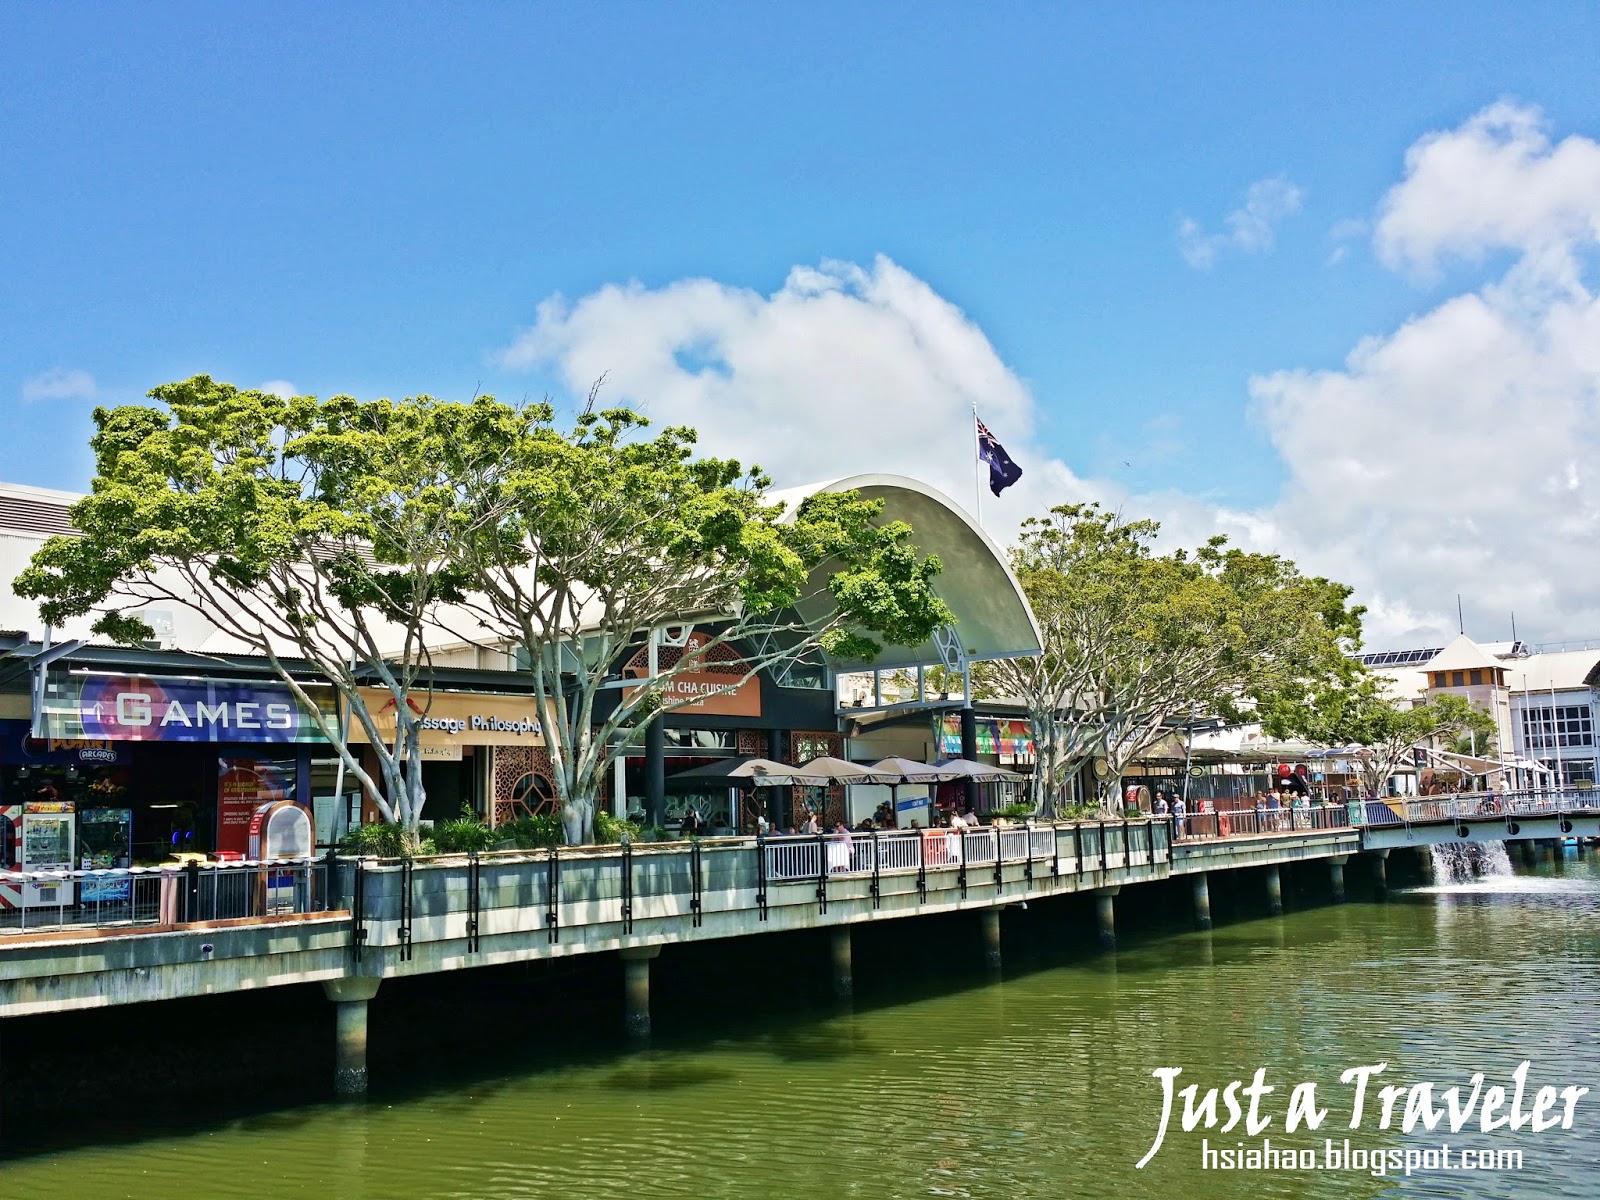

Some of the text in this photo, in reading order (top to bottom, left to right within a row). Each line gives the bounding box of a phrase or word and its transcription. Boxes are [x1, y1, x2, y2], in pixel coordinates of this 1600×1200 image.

[677, 681, 698, 694] CHA
[116, 692, 292, 729] GAMES
[394, 711, 542, 736] ssage Philosophy
[81, 750, 115, 760] ARCADES
